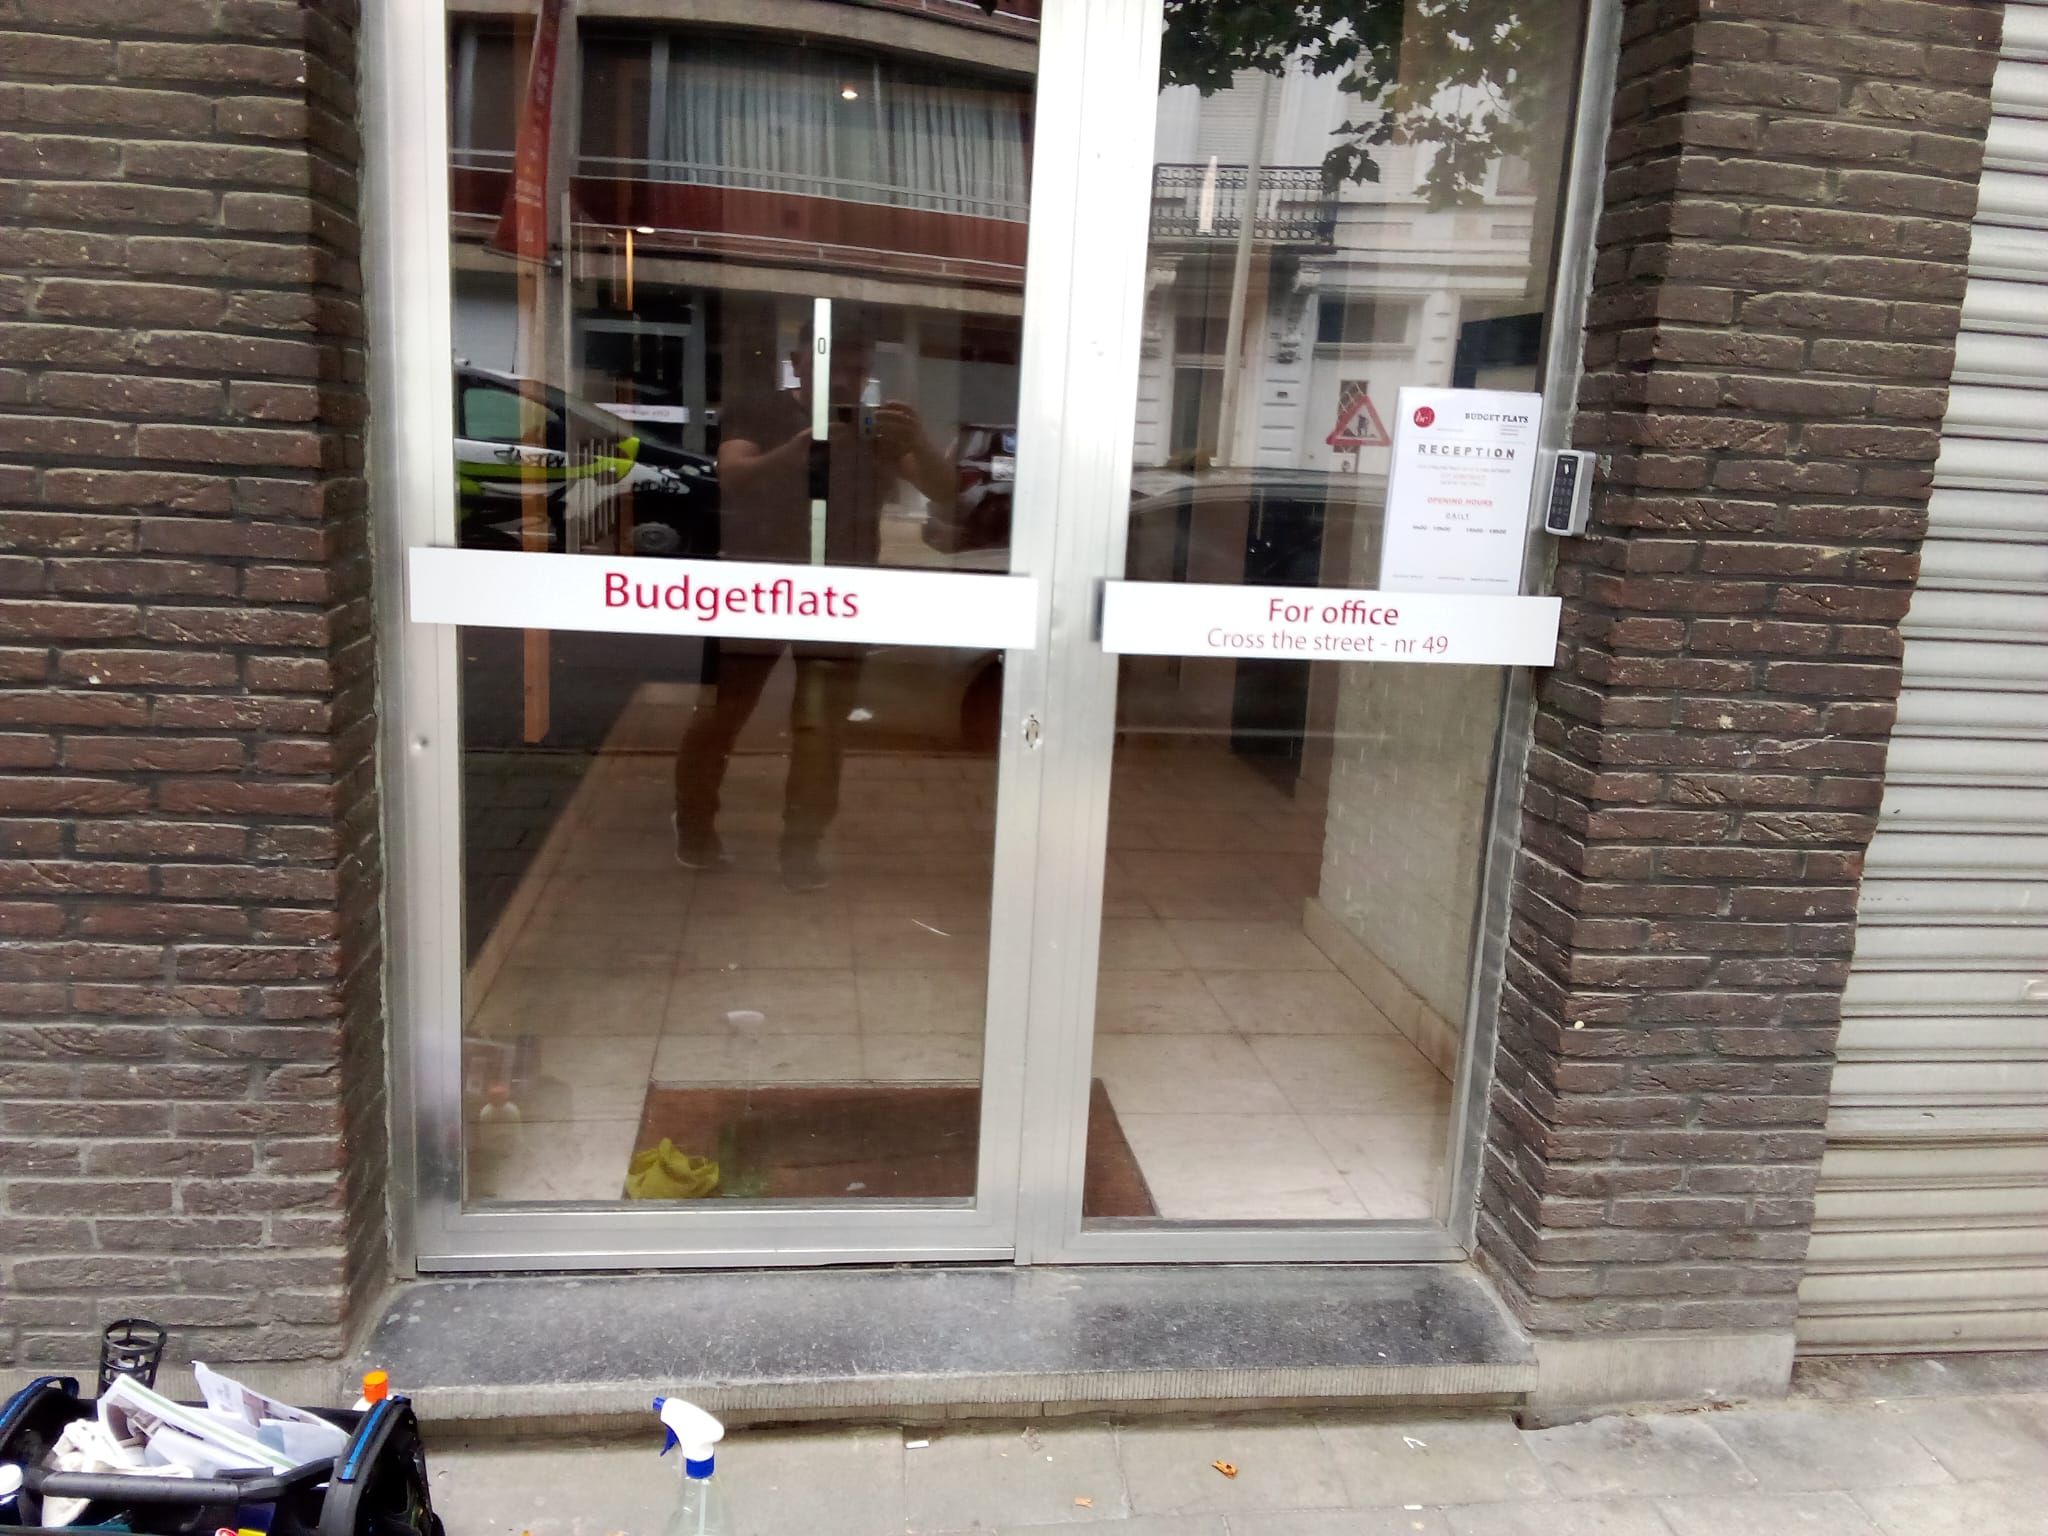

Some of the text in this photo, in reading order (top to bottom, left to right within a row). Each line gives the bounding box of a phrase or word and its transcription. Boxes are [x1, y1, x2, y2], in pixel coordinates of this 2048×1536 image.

[1465, 412, 1529, 424] BUDGET FLATS
[1418, 444, 1515, 460] RECEPTION
[604, 572, 859, 622] Budgetflats
[1268, 598, 1400, 626] For office
[1207, 627, 1265, 649] Cross
[1272, 629, 1307, 650] the
[1314, 633, 1374, 653] street
[1394, 637, 1417, 654] nr
[1422, 635, 1449, 655] 49
